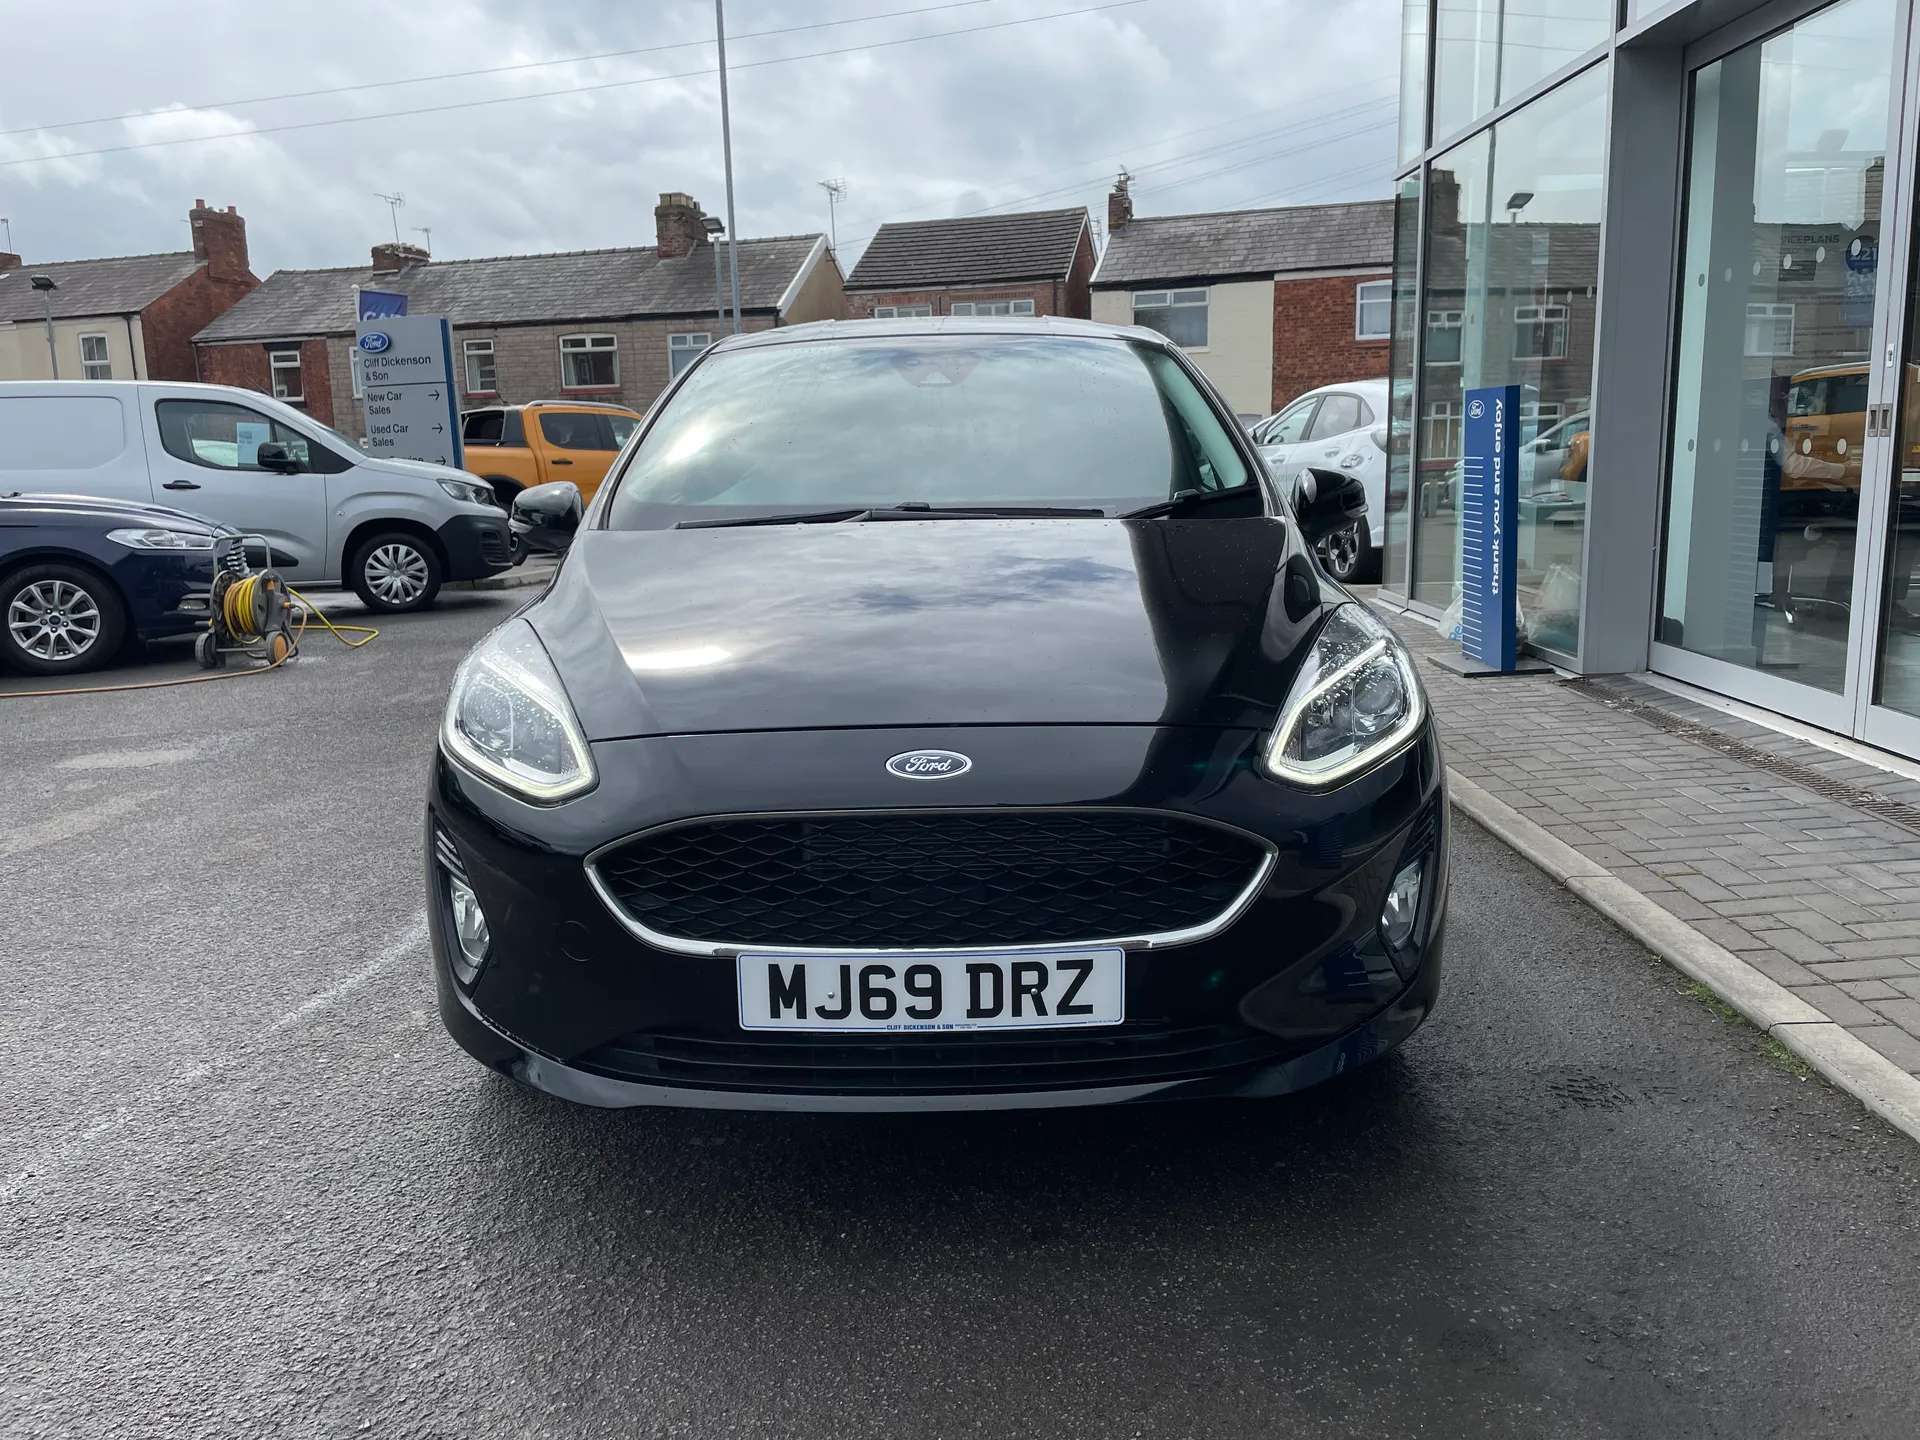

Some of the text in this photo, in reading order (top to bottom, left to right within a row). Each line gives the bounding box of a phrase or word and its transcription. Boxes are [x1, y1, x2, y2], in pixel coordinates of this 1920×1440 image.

[363, 355, 432, 369] Cliff Dickenson
[372, 371, 389, 381] Son
[367, 391, 402, 402] New Car
[368, 405, 391, 415] Sales
[370, 423, 409, 434] Used Car
[372, 437, 394, 447] Sales
[1491, 399, 1503, 595] thank you and enjoy
[905, 756, 951, 771] Ford
[768, 959, 1094, 1020] MJ69 DRZ
